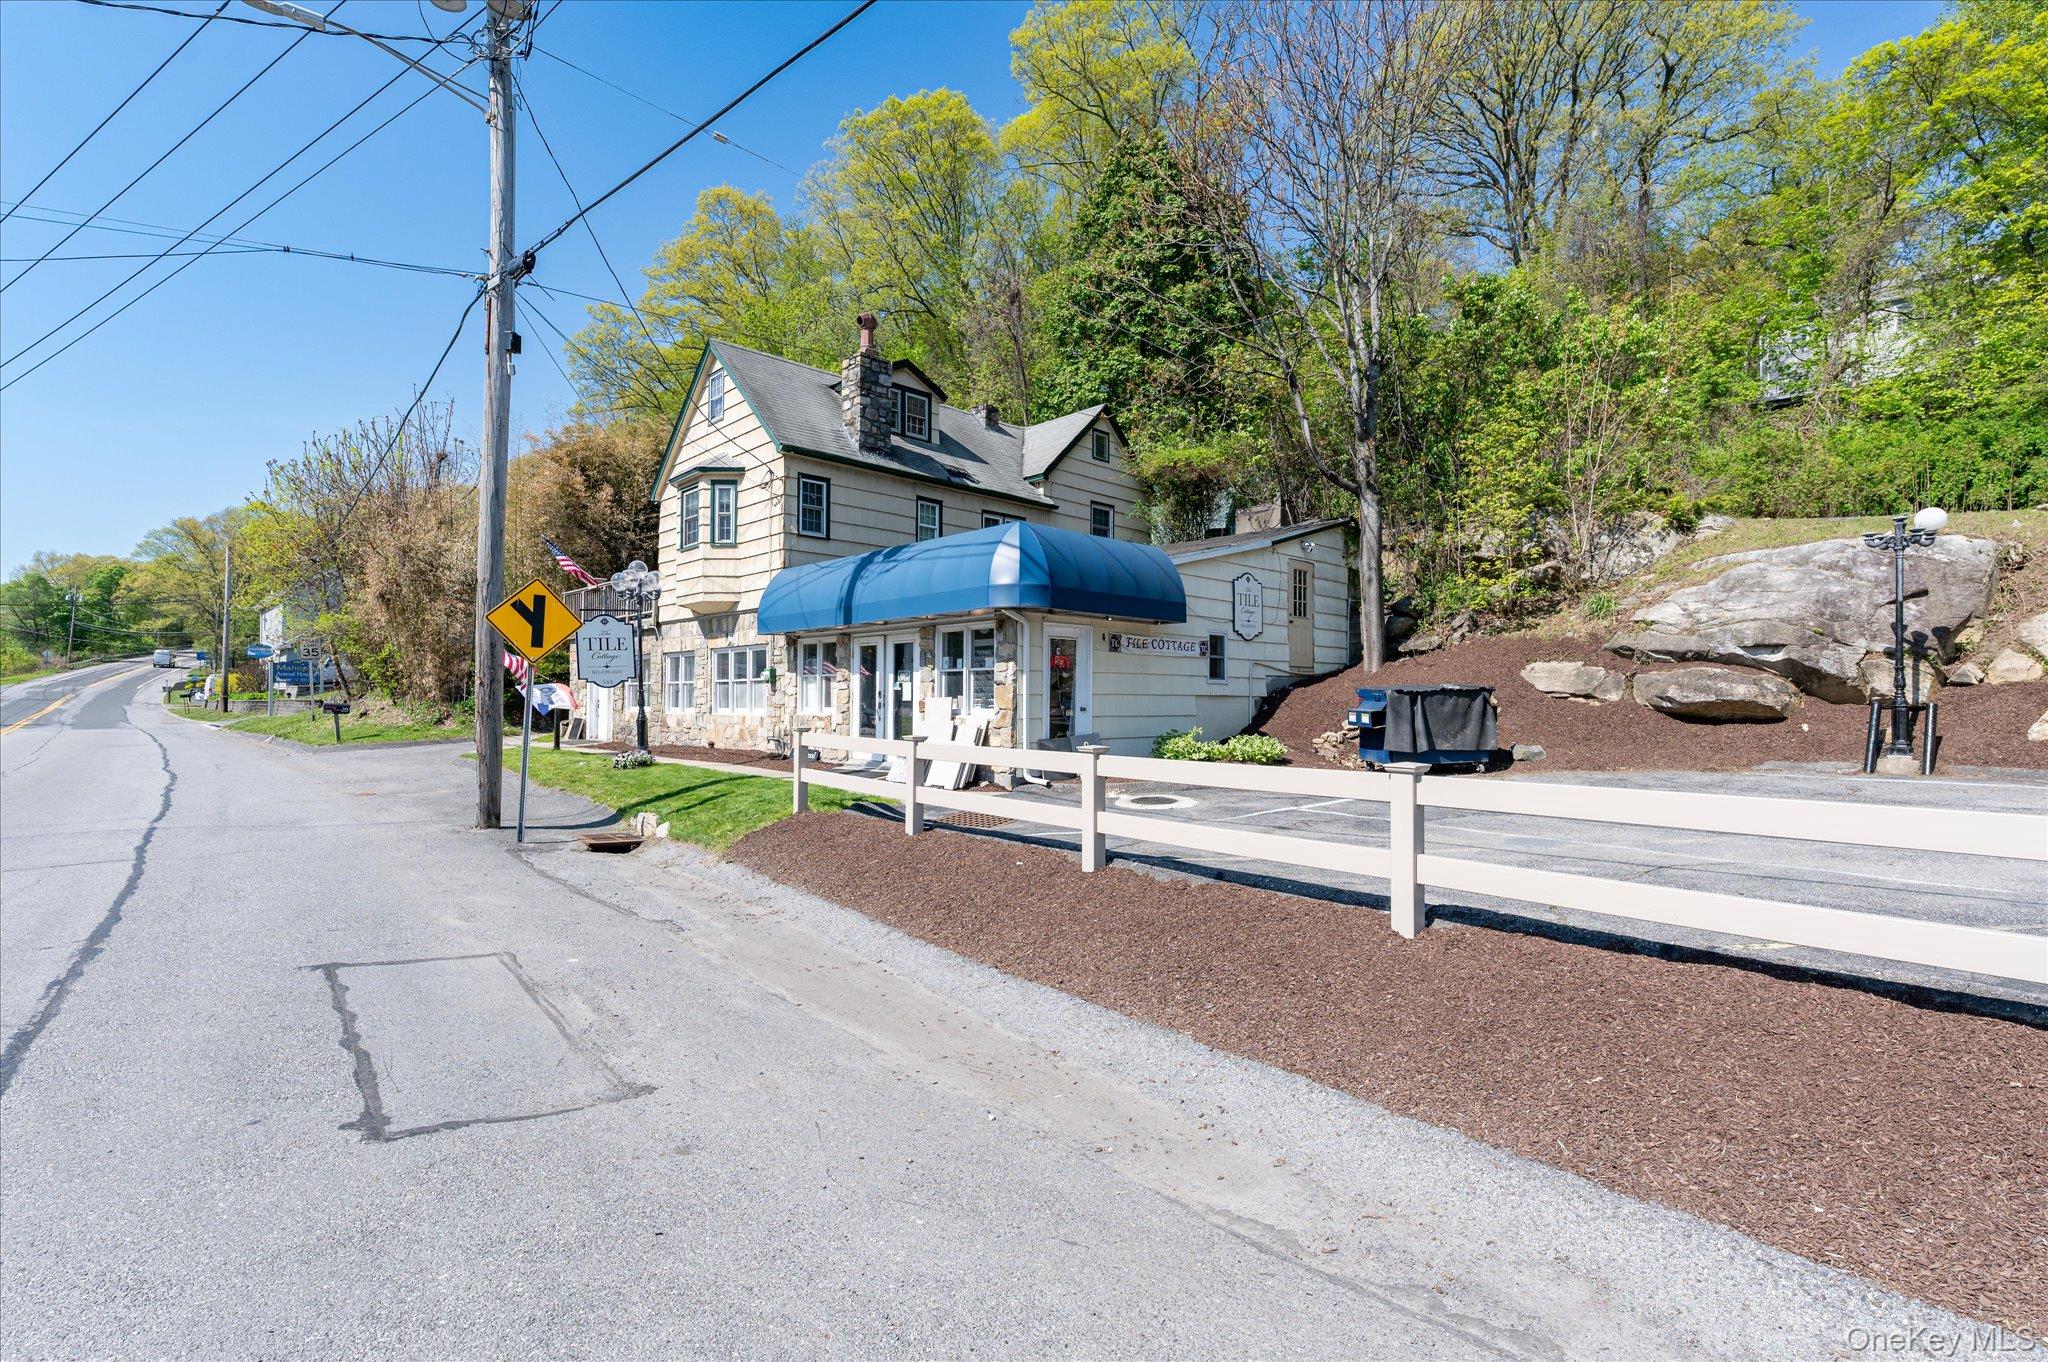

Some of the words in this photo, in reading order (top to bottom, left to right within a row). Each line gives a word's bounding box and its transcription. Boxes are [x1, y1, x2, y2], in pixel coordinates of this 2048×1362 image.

[1237, 592, 1260, 608] TILE
[583, 637, 628, 651] TILE
[1126, 637, 1148, 650] TILE
[1151, 639, 1196, 652] COTTAGE
[303, 648, 320, 657] 35
[591, 651, 622, 665] Cottage
